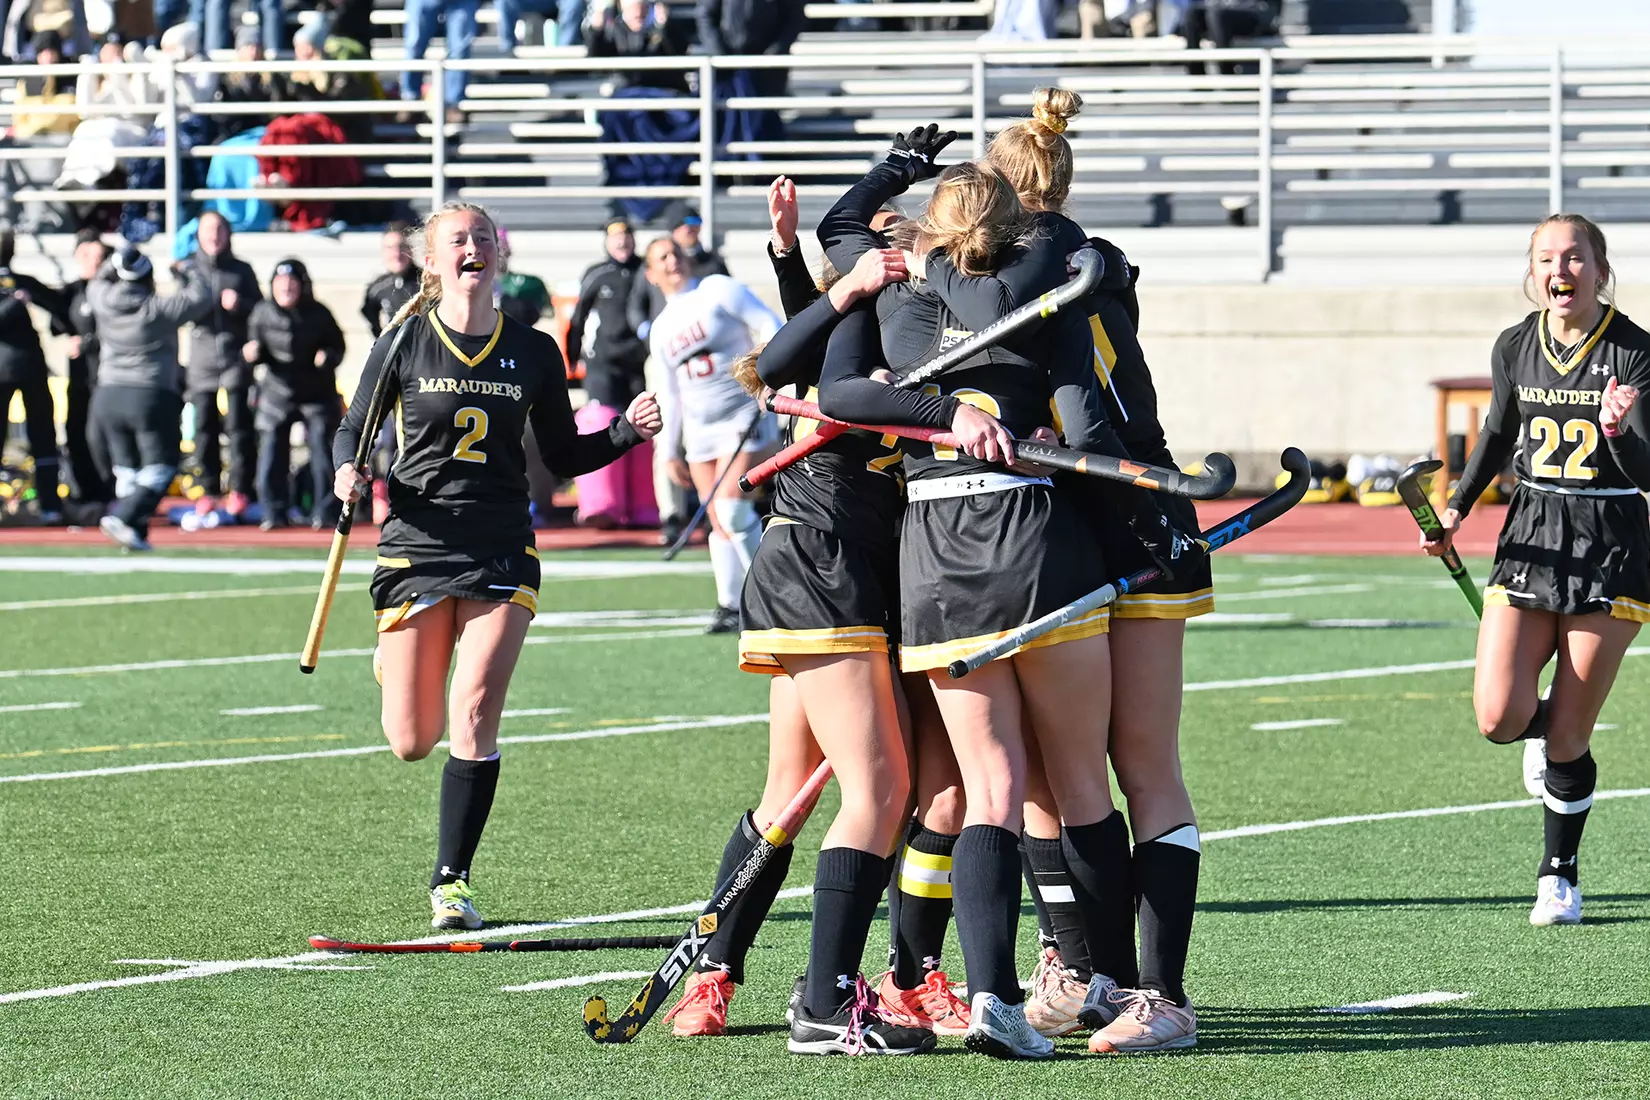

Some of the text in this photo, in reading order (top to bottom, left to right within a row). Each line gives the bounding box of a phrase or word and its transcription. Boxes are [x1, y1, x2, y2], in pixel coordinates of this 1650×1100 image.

[418, 377, 522, 401] MARAUDERS
[1518, 385, 1602, 406] MARAUDER
[453, 406, 489, 464] 2
[1530, 416, 1599, 480] 22
[1207, 513, 1252, 552] STX
[1411, 503, 1441, 534] STX
[659, 925, 708, 990] STX
